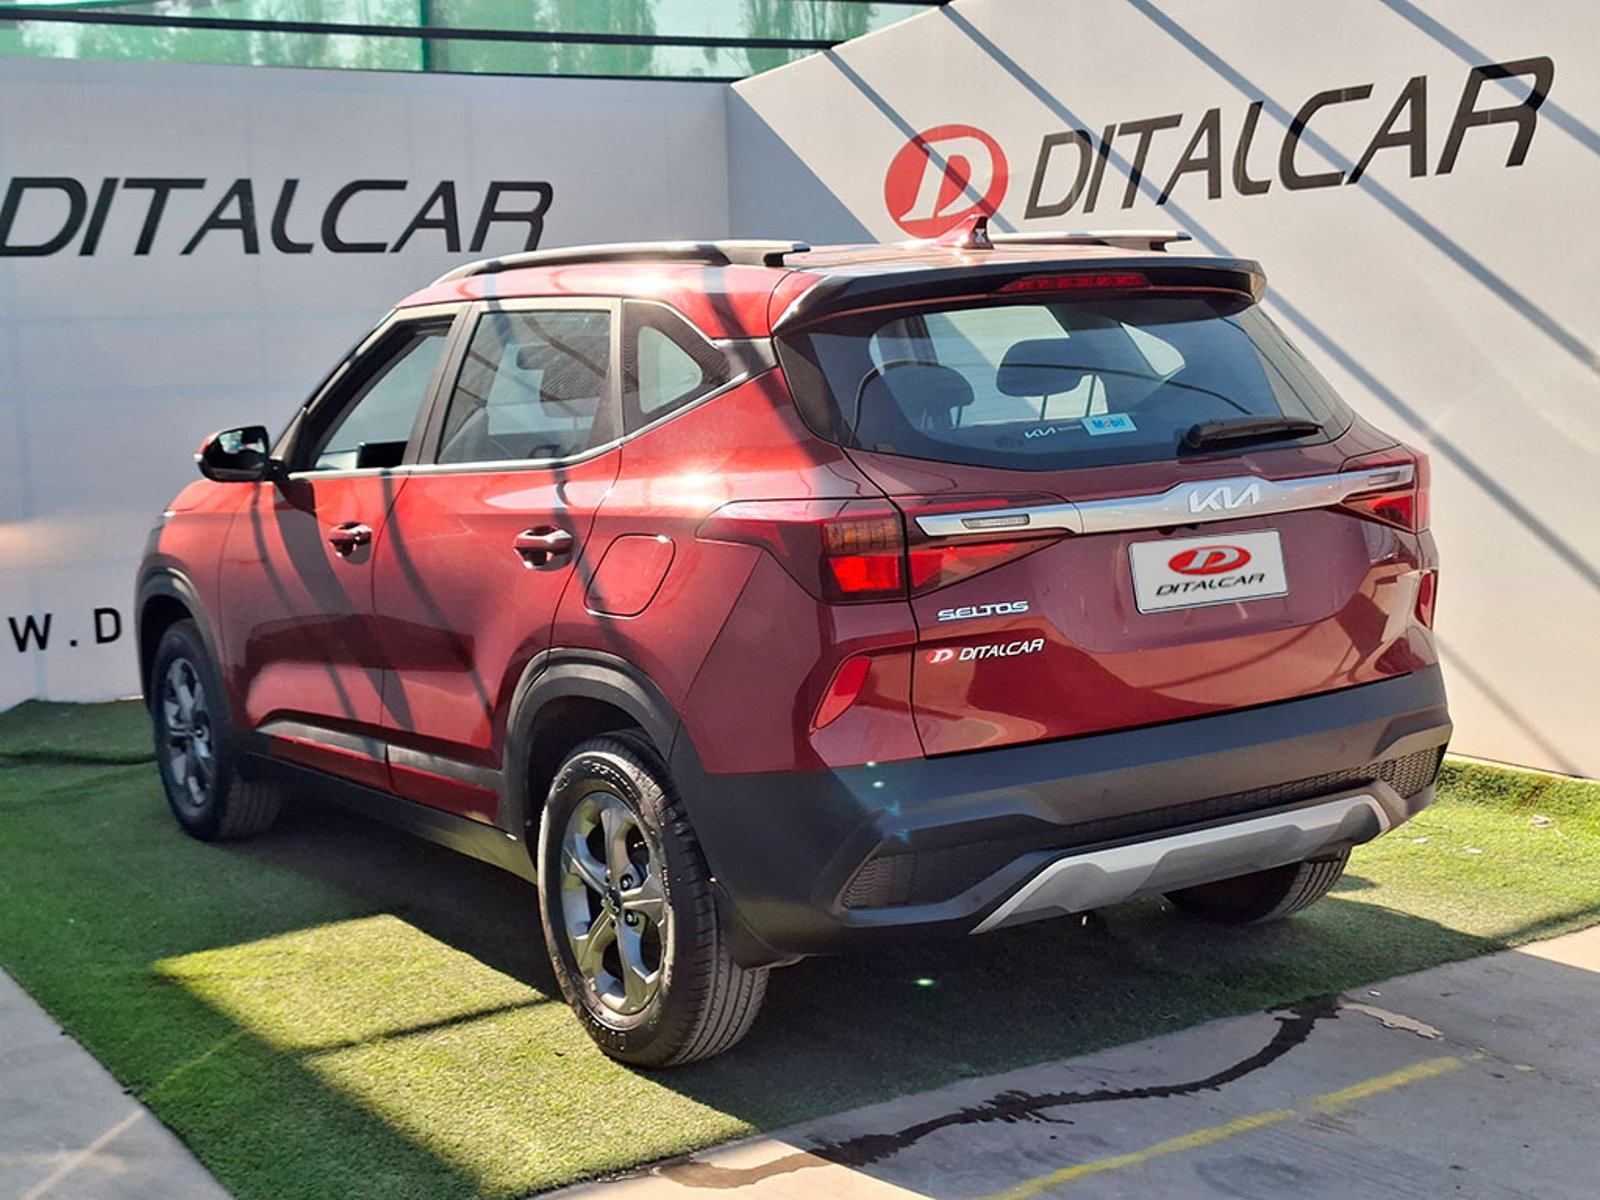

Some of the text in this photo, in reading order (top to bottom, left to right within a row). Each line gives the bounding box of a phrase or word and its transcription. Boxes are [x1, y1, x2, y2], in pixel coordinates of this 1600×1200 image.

[1024, 56, 1554, 219] DITALCAR
[0, 177, 553, 256] DITALCAR
[1189, 483, 1260, 513] KIA
[1156, 573, 1265, 596] DITALCAR
[937, 600, 1029, 621] SELTOS
[958, 638, 1045, 661] DITALCAR
